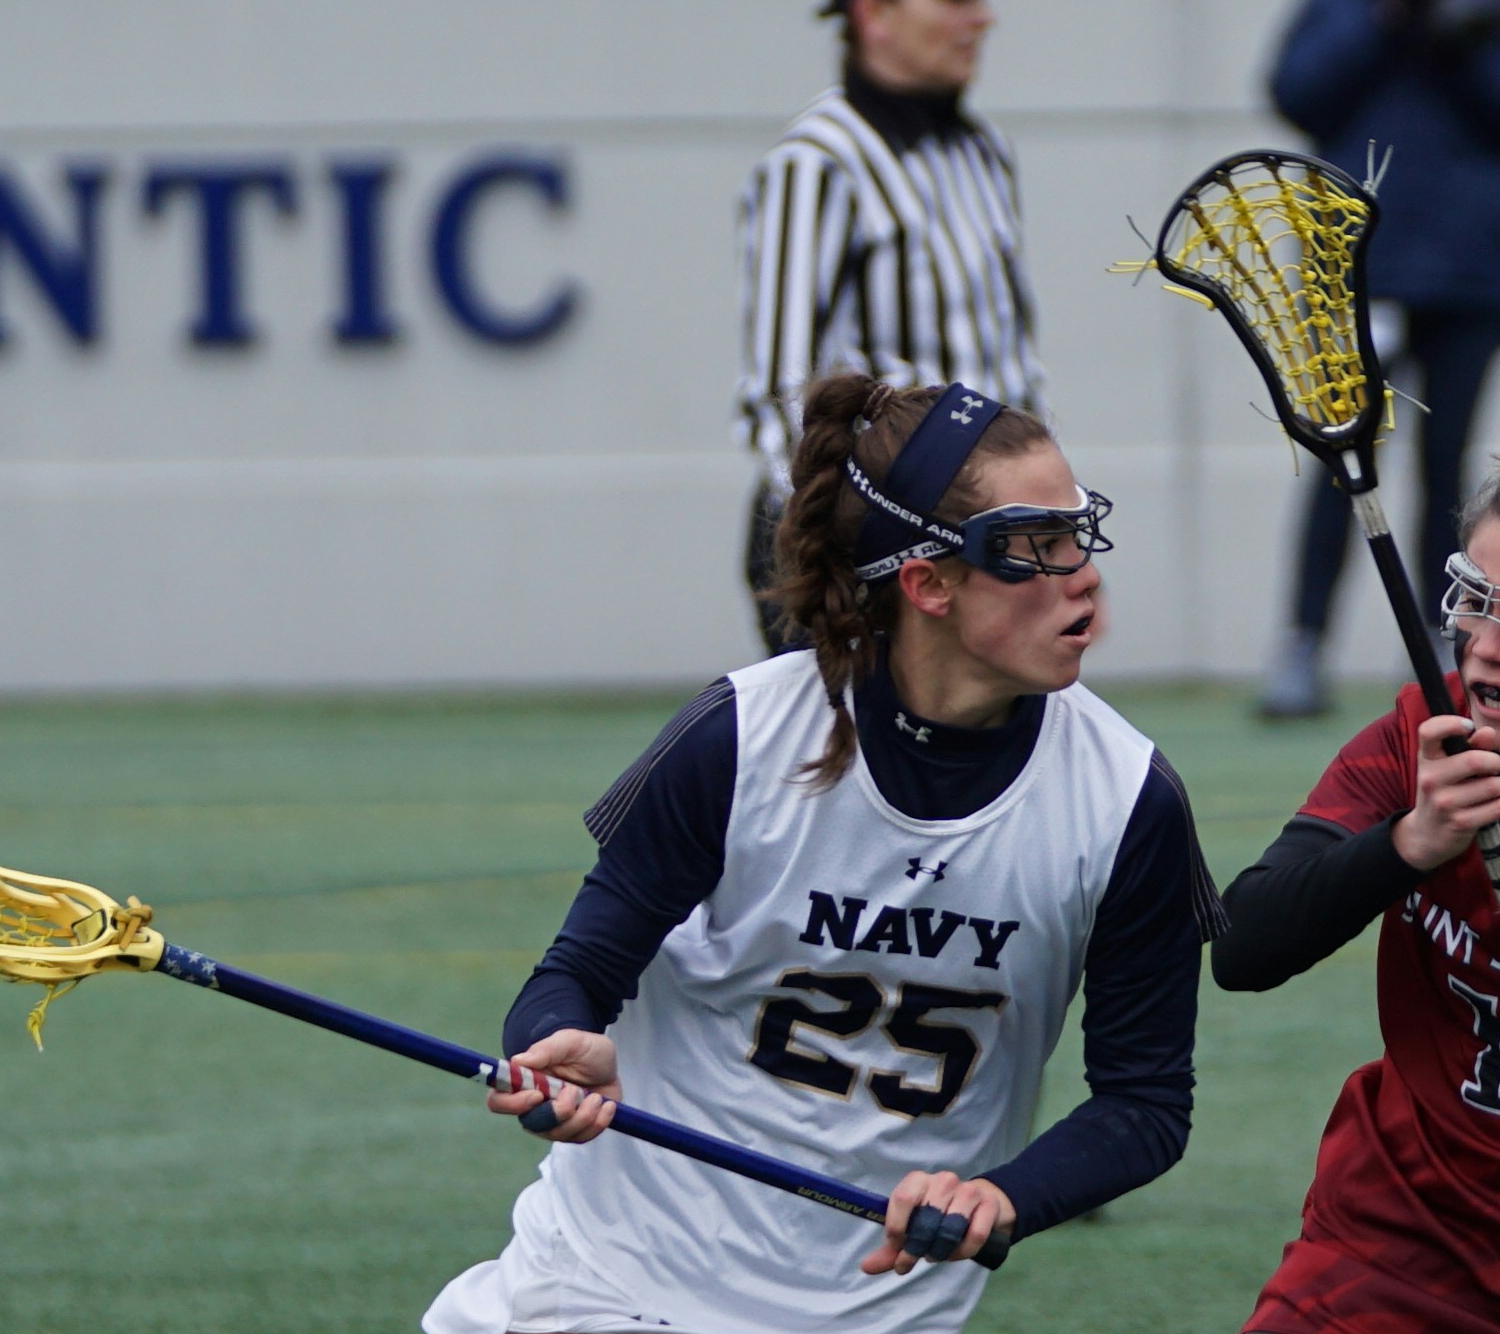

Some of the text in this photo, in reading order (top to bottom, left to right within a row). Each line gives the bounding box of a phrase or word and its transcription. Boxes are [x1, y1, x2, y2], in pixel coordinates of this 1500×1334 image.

[867, 487, 924, 527] UNDER
[799, 890, 1020, 970] NAVY
[746, 966, 1011, 1123] 25
